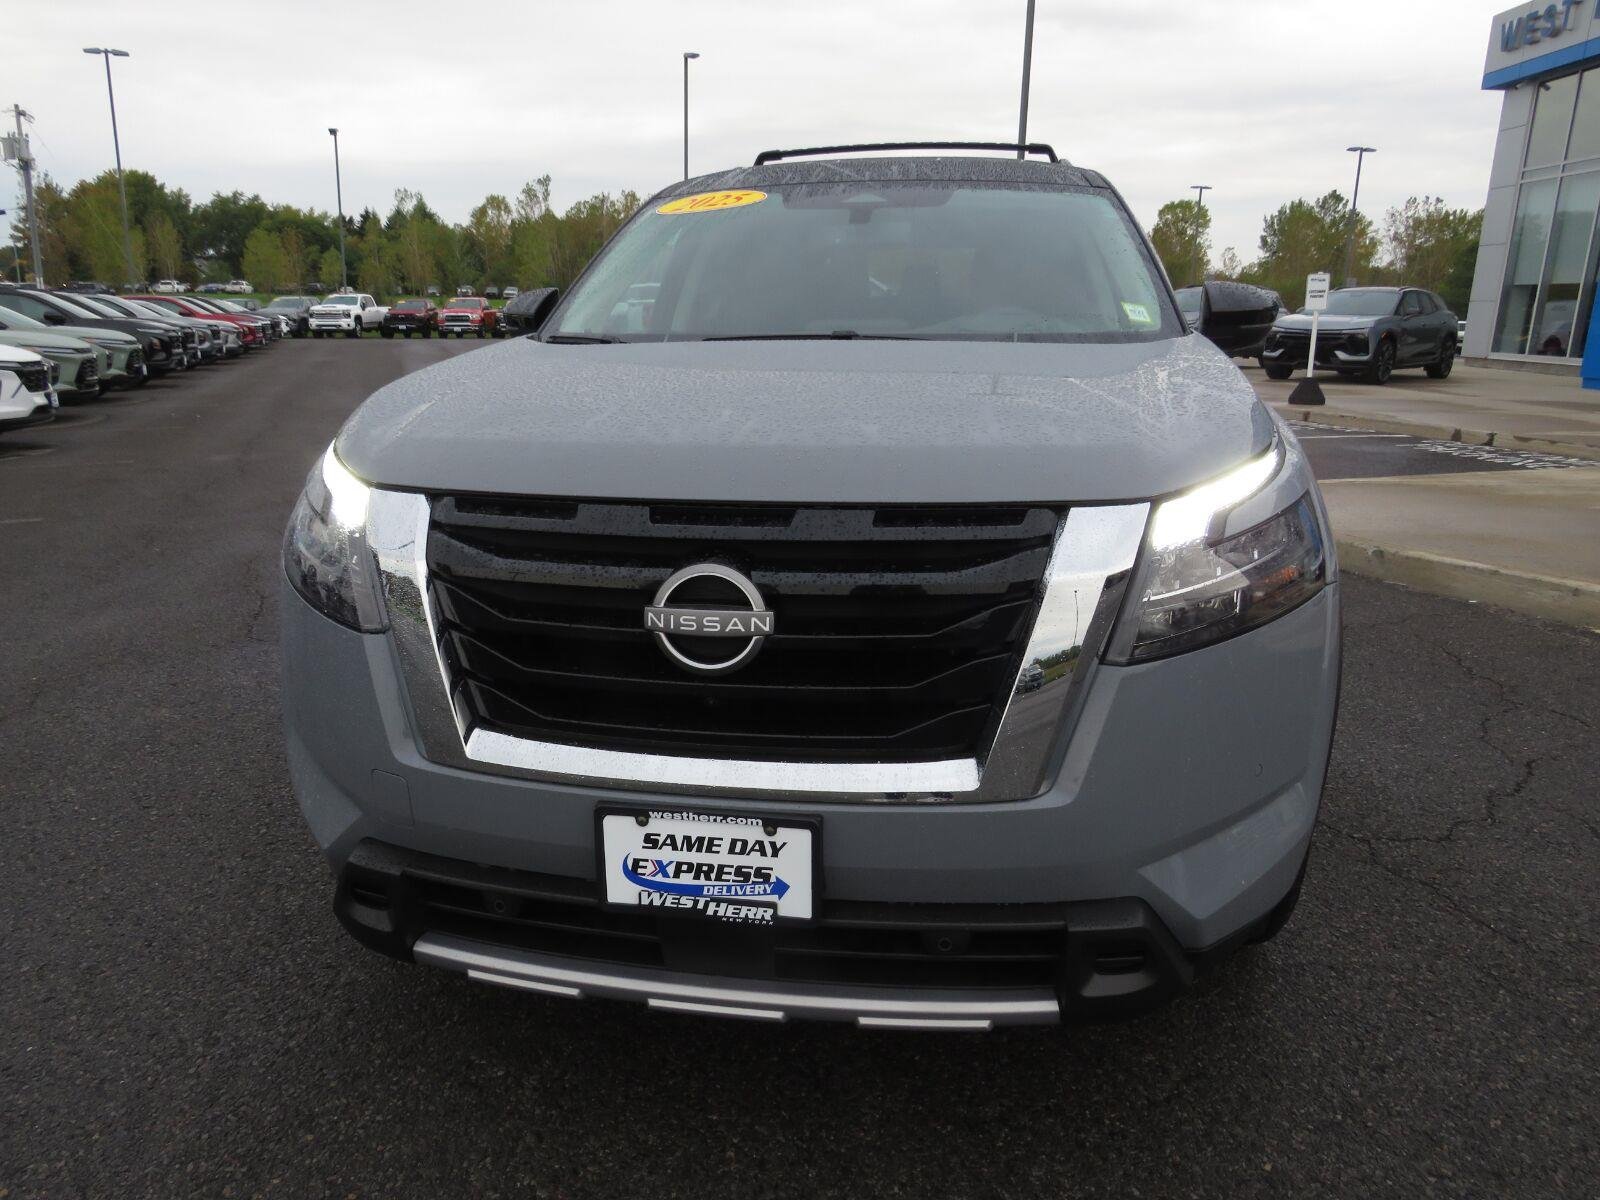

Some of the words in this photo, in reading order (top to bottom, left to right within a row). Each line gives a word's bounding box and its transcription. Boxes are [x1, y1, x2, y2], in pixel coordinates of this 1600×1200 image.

[1500, 0, 1578, 52] WEST
[647, 611, 770, 632] NISSAN
[648, 811, 763, 826] westherr.com
[642, 832, 723, 855] SAME
[728, 838, 788, 858] DAY
[631, 857, 774, 883] EXPRESS
[703, 883, 775, 895] DELIVERY
